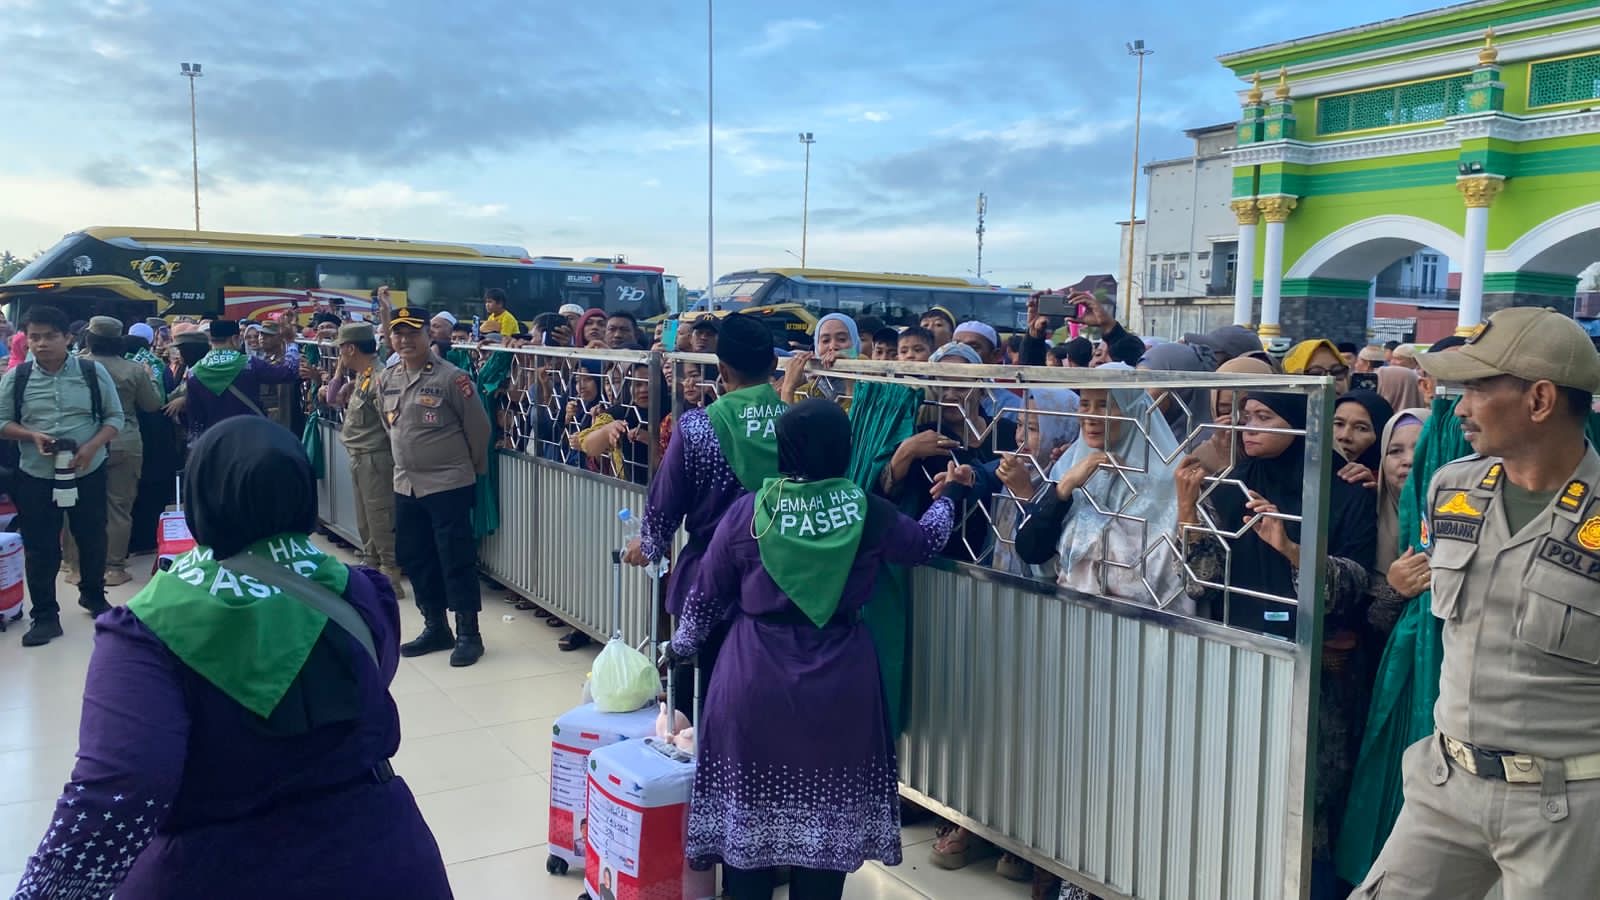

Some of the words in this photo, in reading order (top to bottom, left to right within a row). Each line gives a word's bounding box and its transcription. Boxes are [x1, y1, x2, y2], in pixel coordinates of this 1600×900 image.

[771, 495, 825, 513] JEMAAH
[780, 502, 863, 537] PASER
[1548, 543, 1582, 570] POL
